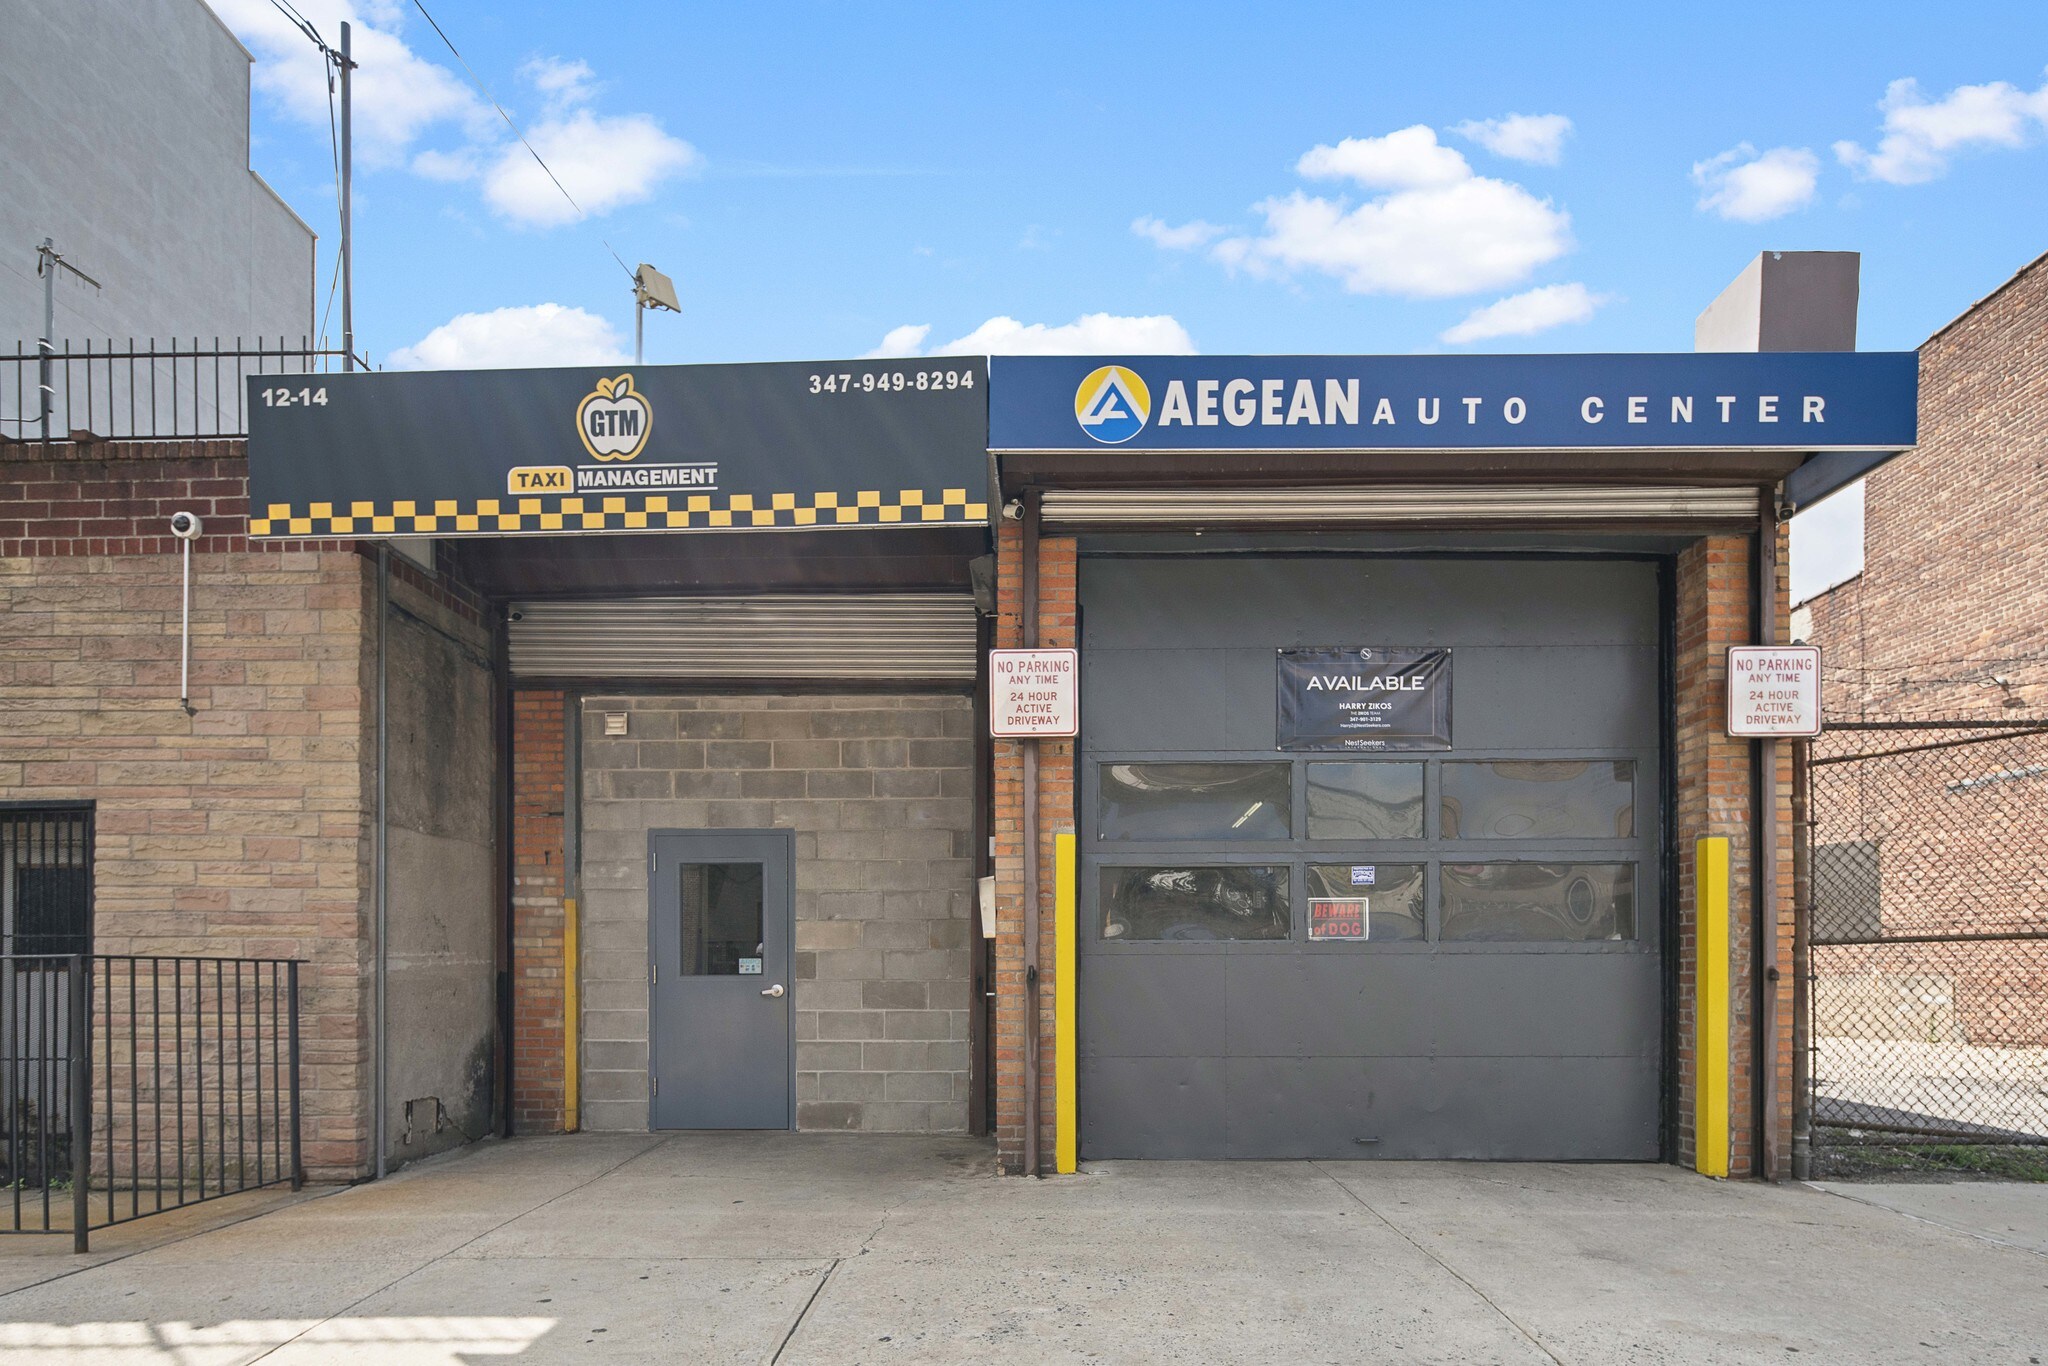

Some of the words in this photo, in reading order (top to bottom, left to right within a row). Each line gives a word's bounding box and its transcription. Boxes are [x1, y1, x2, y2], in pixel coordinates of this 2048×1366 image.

[809, 370, 974, 394] 347-949-8294
[261, 387, 329, 408] 12-14
[1158, 378, 1360, 427] AEGEAN
[1372, 397, 1527, 425] AUTO
[1580, 396, 1825, 424] CENTER
[590, 409, 639, 438] GTM
[517, 472, 565, 488] TAXI
[577, 468, 718, 487] MANAGEMENT
[997, 661, 1014, 673] NO
[1018, 660, 1070, 673] PARKING
[1736, 659, 1753, 671] NO
[1758, 658, 1812, 671] PARKING
[1008, 675, 1031, 685] ANY
[1035, 674, 1059, 685] TIME
[1306, 676, 1425, 691] AVAILABLE
[1748, 673, 1771, 683] ANY
[1776, 673, 1800, 683] TIME
[1010, 691, 1024, 702] 24
[1028, 691, 1057, 701] HOUR
[1749, 690, 1764, 700] 24
[1768, 690, 1799, 700] HOUR
[1016, 703, 1052, 714] ACTIVE
[1339, 702, 1367, 710] HARRY
[1368, 702, 1392, 710] ZIKOS
[1755, 702, 1793, 712] ACTIVE
[1007, 715, 1060, 726] DRIVEWAY
[1746, 714, 1801, 725] DRIVEWAY
[1314, 903, 1360, 918] BEWARE
[1313, 922, 1326, 936] of
[1328, 922, 1361, 936] DOG
